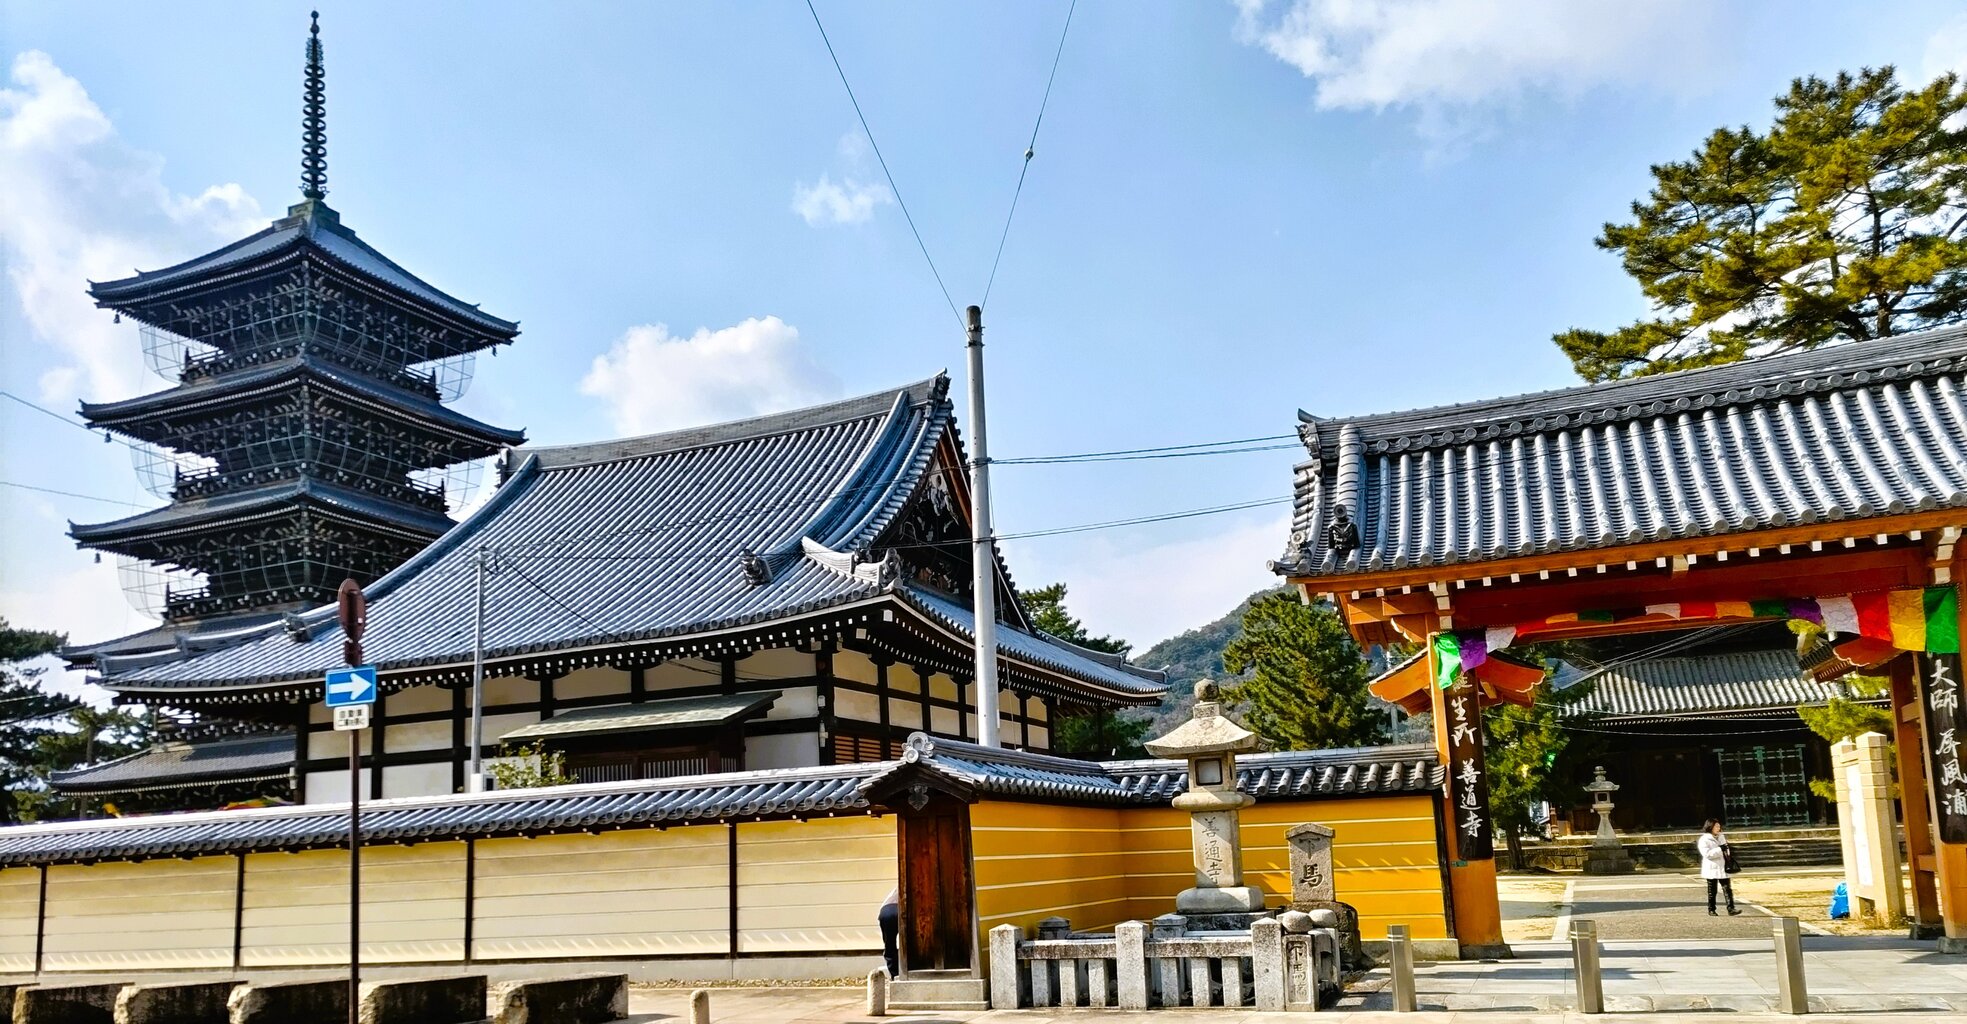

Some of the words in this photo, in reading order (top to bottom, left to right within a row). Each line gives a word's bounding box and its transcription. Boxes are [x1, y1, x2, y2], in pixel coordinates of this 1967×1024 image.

[1202, 816, 1223, 884] 善通寺
[1299, 837, 1324, 887] 下馬
